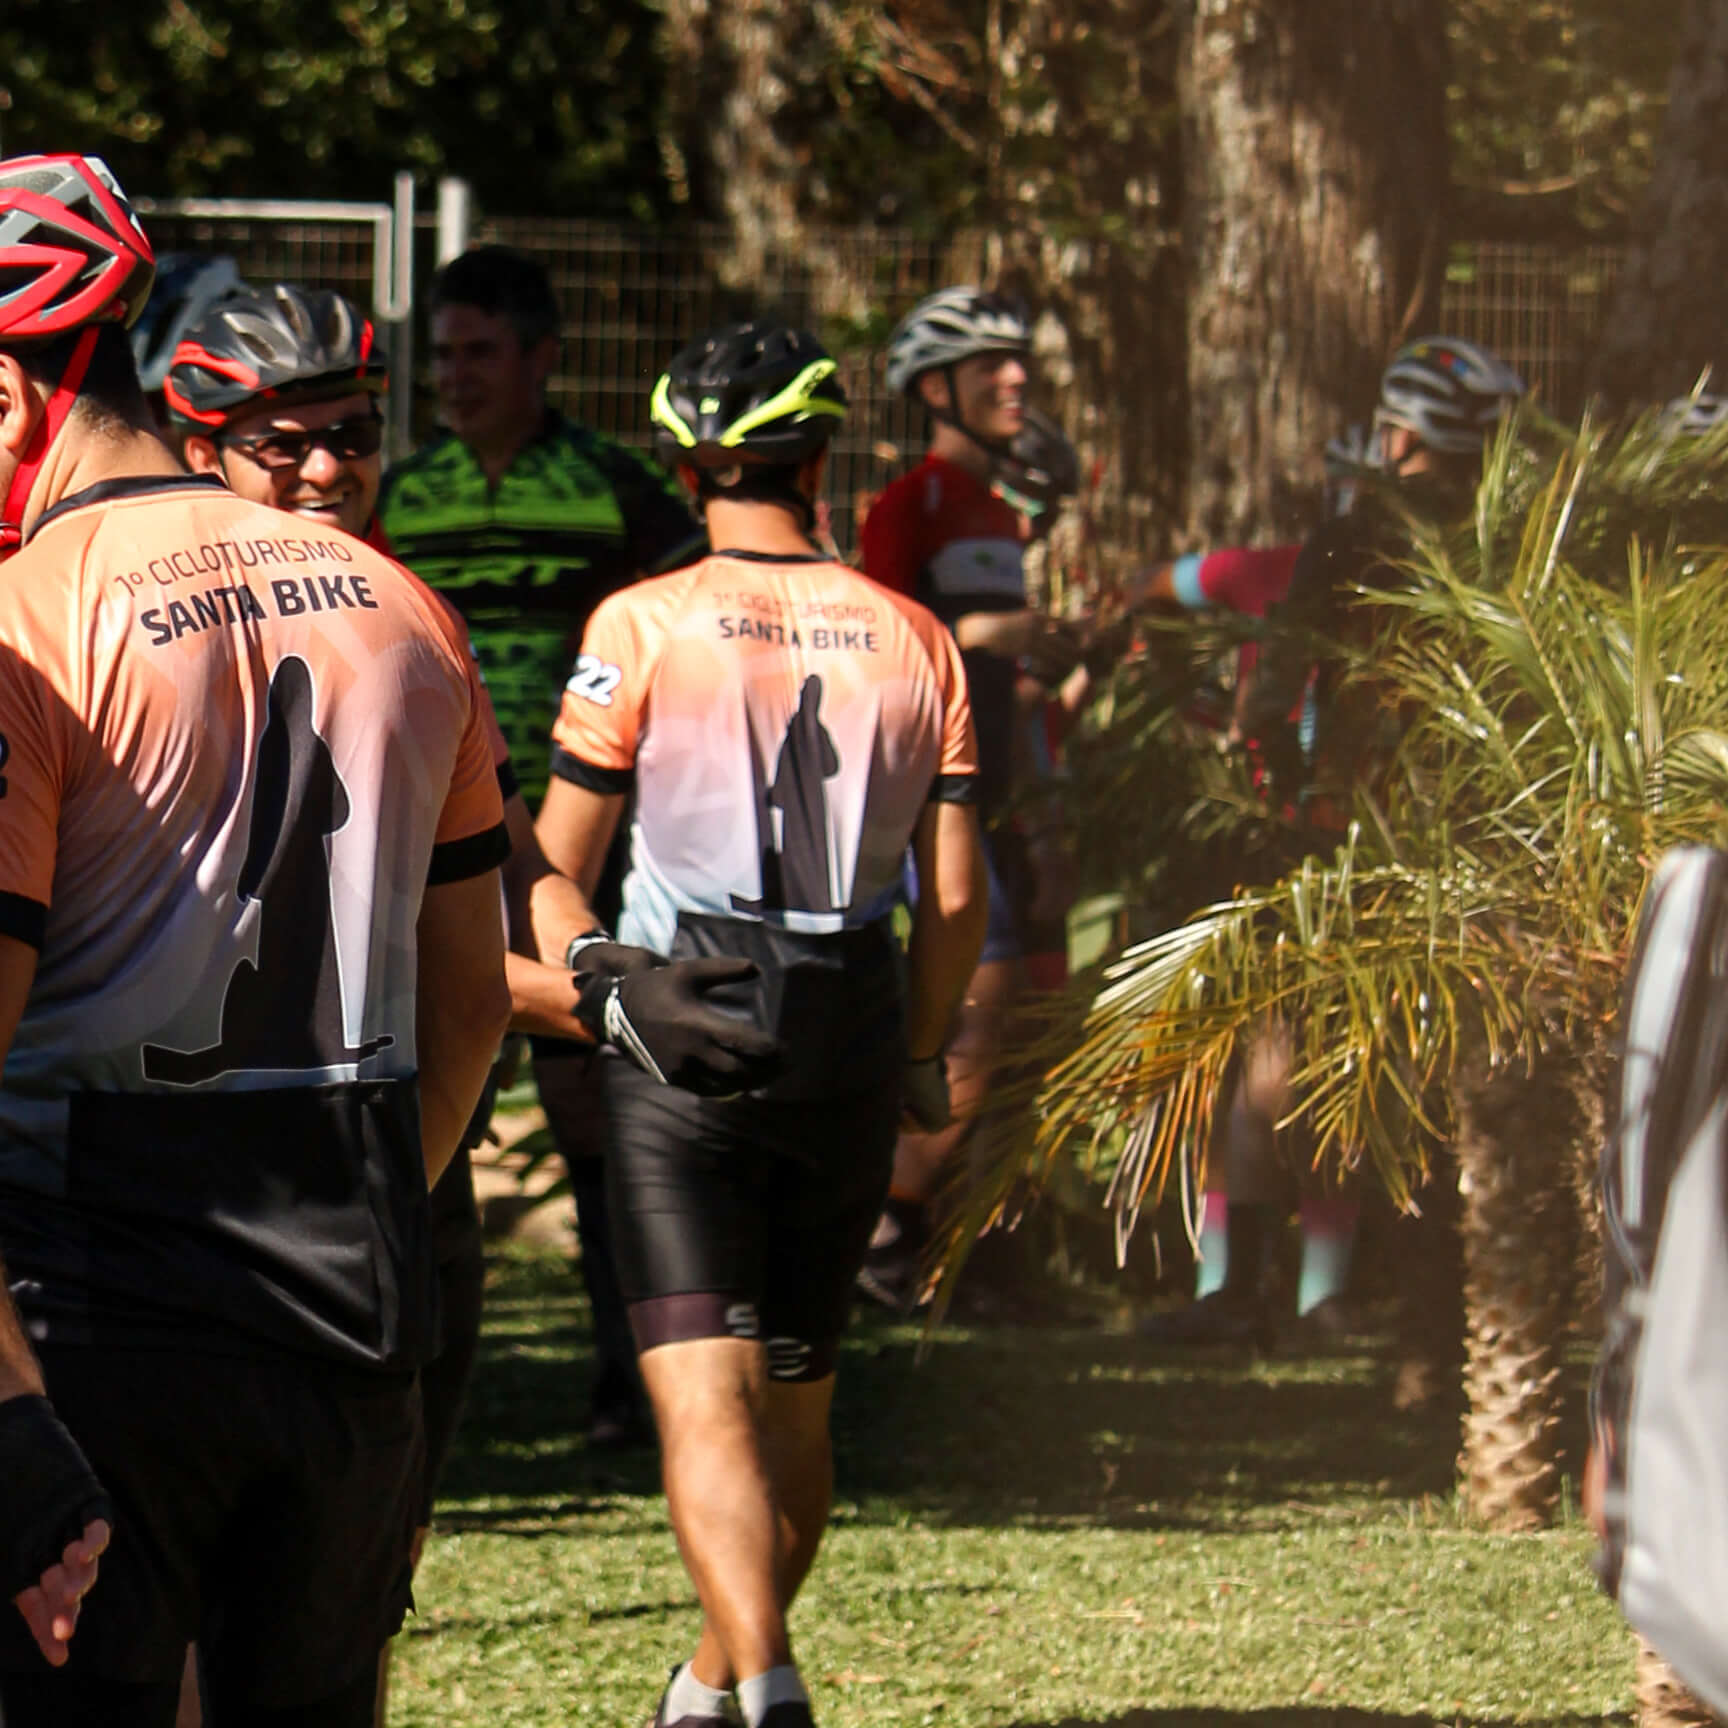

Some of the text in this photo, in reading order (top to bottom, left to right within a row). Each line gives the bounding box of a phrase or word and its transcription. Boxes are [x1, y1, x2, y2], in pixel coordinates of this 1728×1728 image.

[148, 539, 353, 586] CICLOTURISMO
[140, 575, 379, 647] SANTA BIKE
[719, 617, 880, 653] SANTA BIKE
